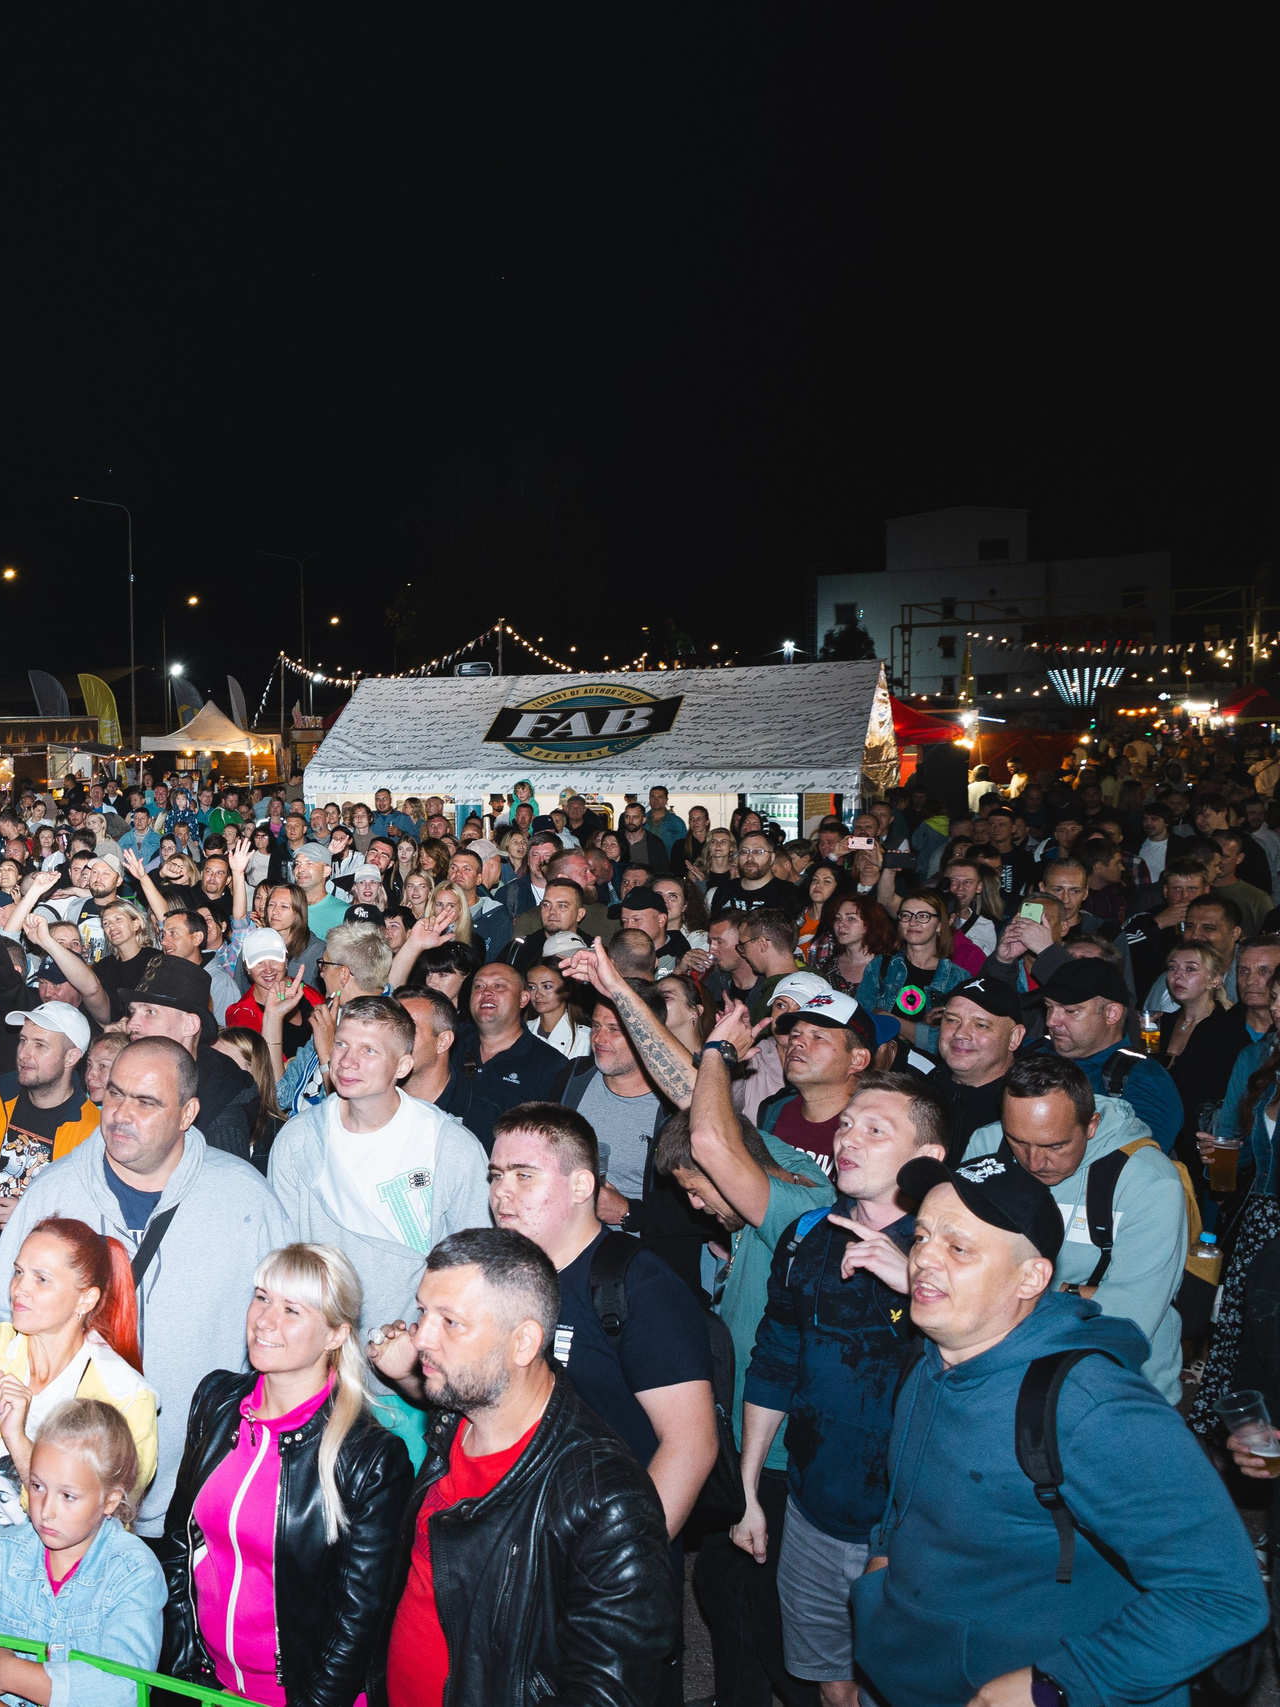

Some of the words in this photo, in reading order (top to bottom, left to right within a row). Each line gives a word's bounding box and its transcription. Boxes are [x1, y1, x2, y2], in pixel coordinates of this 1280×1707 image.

[532, 692, 567, 708] FACTORY
[570, 688, 581, 697] OF
[583, 687, 624, 697] AUTHOR'S
[623, 690, 644, 703] BEER
[506, 706, 656, 739] FAB
[534, 749, 605, 760] BREWERY
